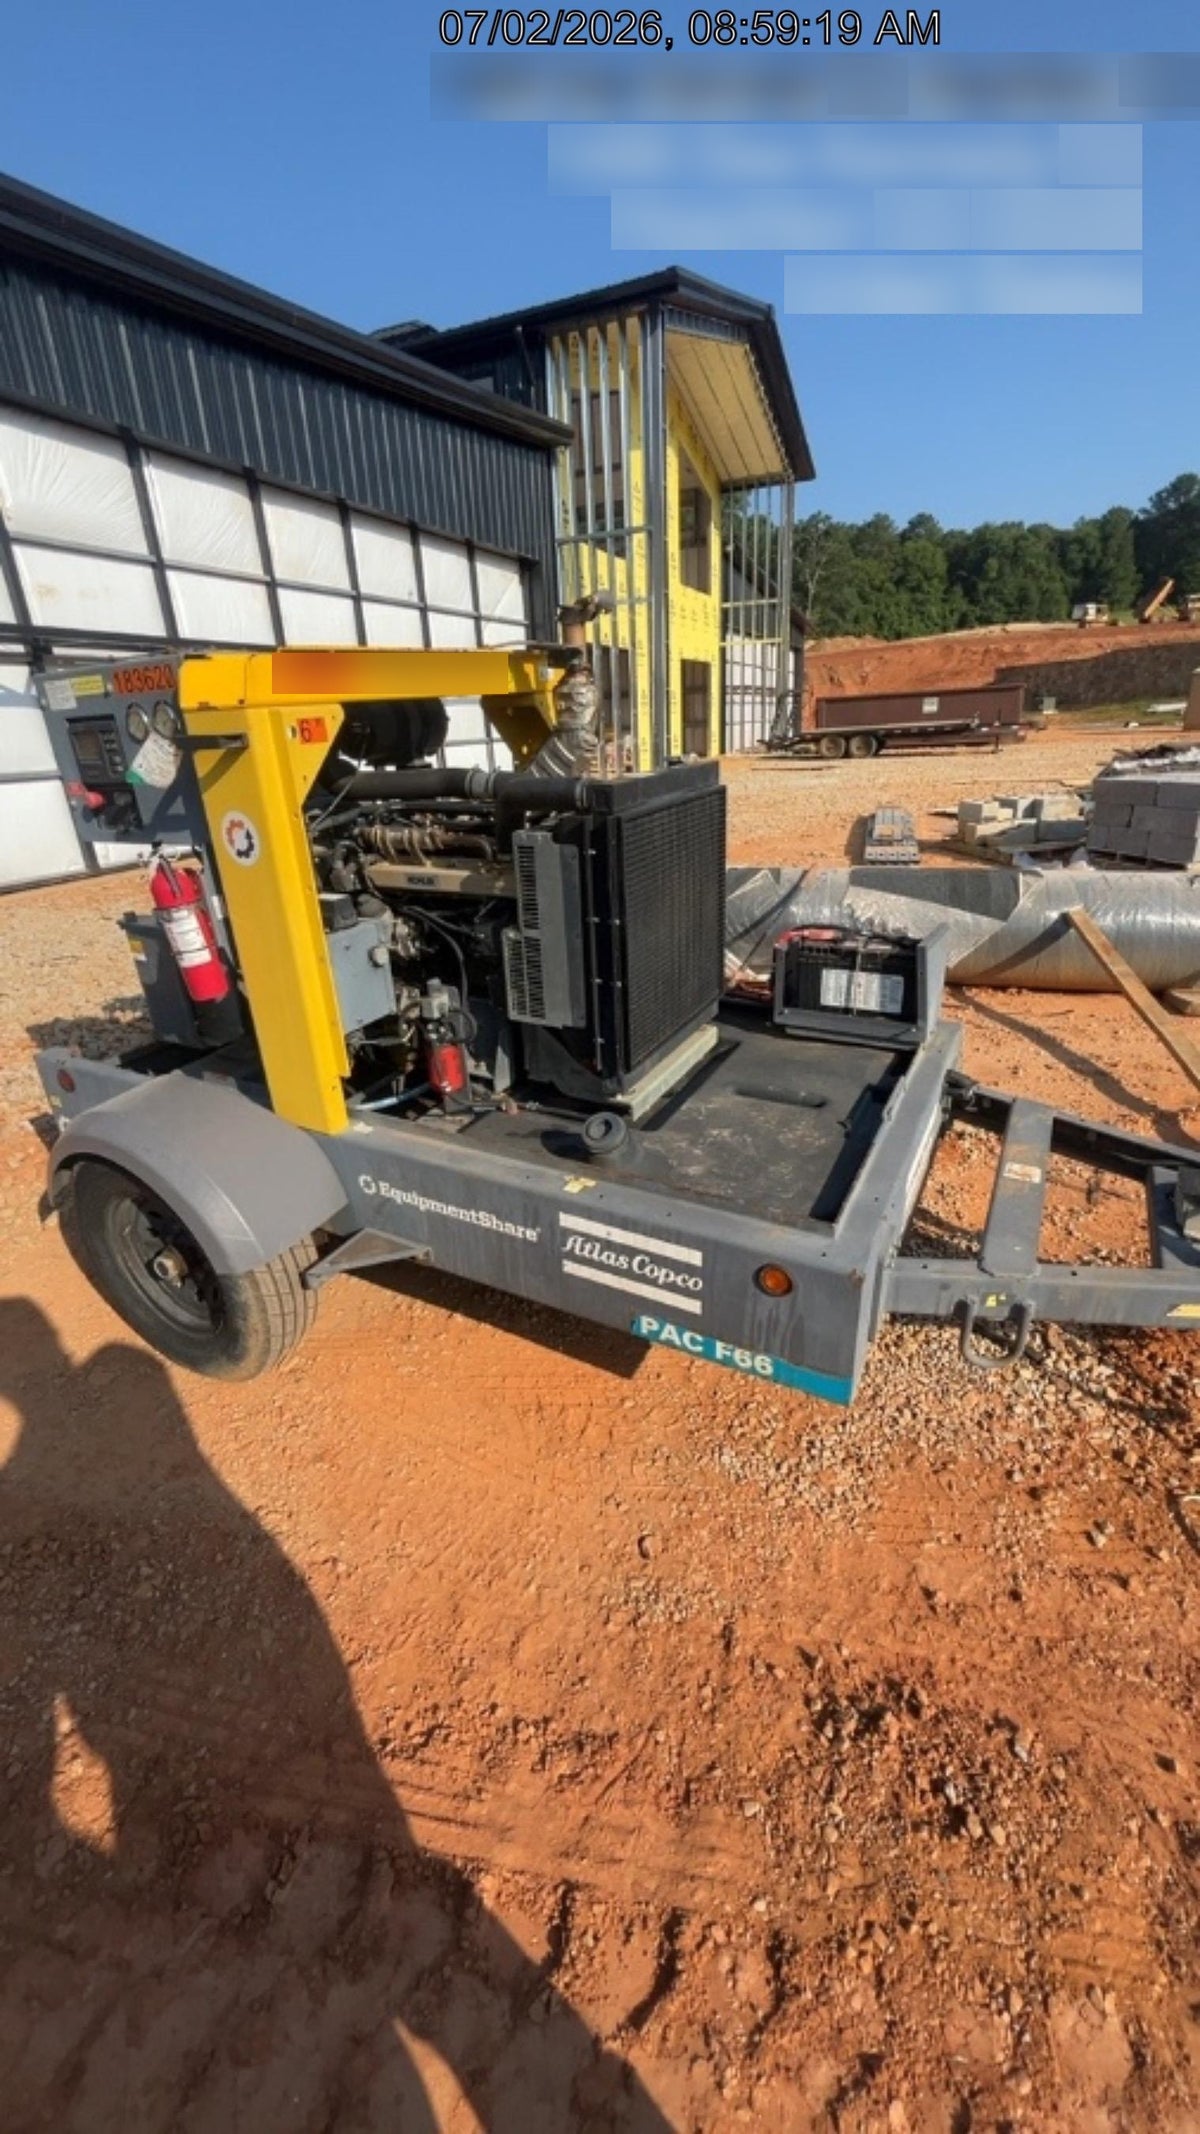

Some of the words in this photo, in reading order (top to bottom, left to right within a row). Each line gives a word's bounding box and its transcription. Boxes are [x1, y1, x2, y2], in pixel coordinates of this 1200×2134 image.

[113, 663, 175, 694] 183620
[378, 1181, 538, 1243] EquipmentShare
[562, 1234, 630, 1269] Atlas
[632, 1253, 703, 1291] Copco
[639, 1315, 703, 1352] PAC
[715, 1339, 775, 1376] F66
